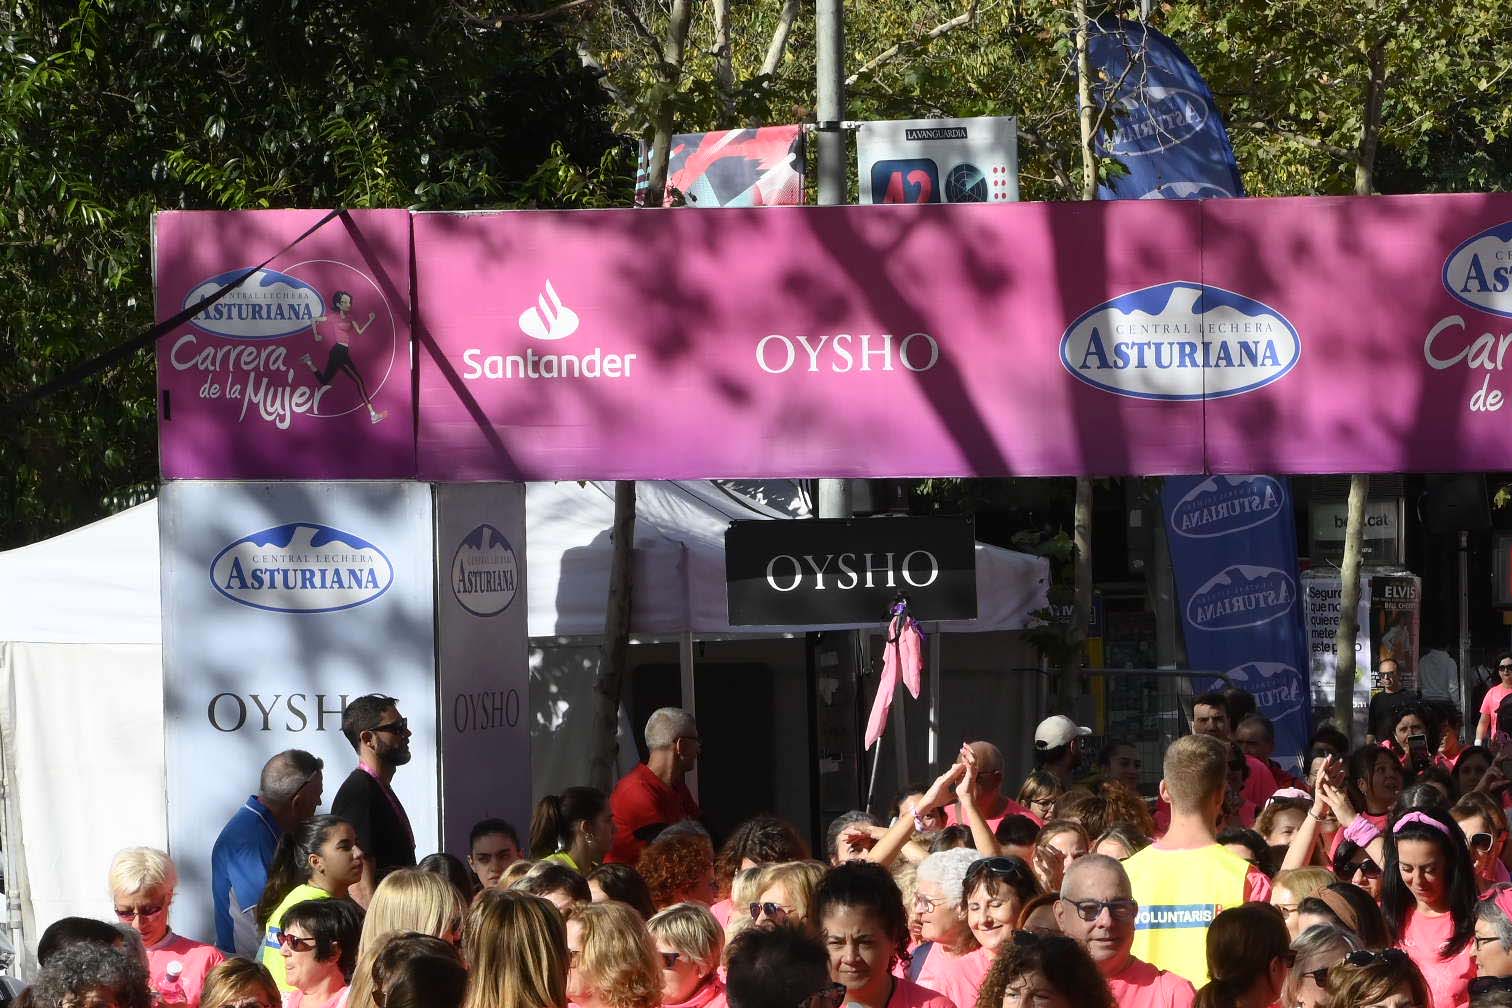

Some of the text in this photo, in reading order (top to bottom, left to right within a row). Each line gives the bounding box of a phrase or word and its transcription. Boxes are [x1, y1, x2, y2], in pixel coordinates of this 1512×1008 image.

[1115, 323, 1274, 335] CENTRAL LECHERA
[170, 334, 288, 371] Carrera
[463, 347, 637, 379] Santander
[756, 333, 939, 374] OYSHO
[1078, 326, 1282, 370] ASTURIANA
[200, 367, 332, 430] de la Mujer
[1470, 373, 1504, 412] de
[224, 555, 381, 590] ASTURIANA
[253, 553, 374, 563] CENTRAL LECHERA
[457, 558, 514, 594] ASTURIANA
[766, 550, 939, 592] OYSHO
[1310, 602, 1328, 614] que
[1385, 585, 1416, 599] ELVIS
[1312, 641, 1330, 652] este
[207, 692, 392, 733] OYSH
[454, 689, 520, 734] OYSHO
